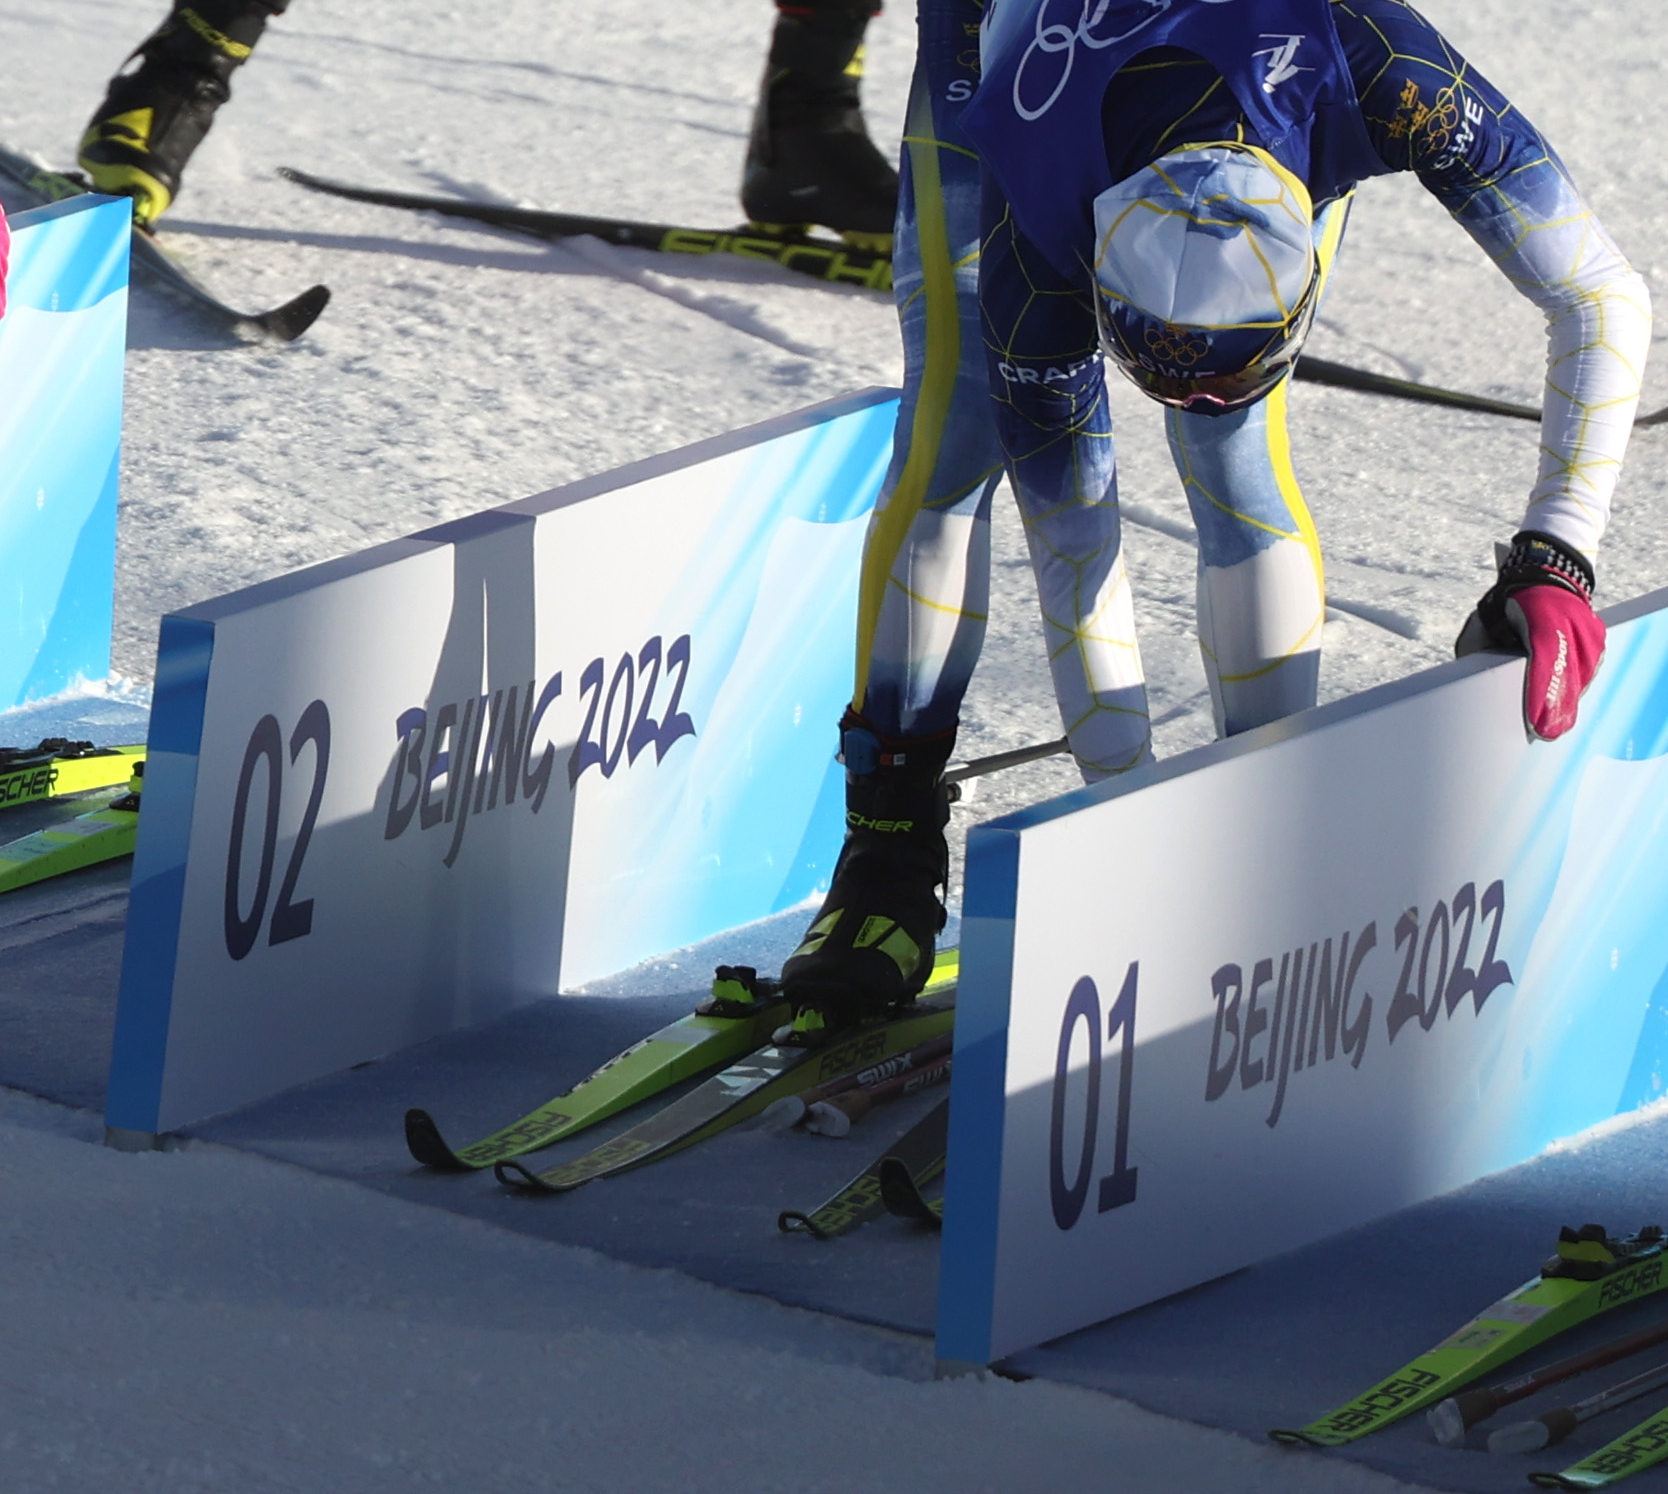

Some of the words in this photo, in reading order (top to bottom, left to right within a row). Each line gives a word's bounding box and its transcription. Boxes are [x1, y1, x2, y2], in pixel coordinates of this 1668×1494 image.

[659, 228, 893, 291] FISCH
[224, 699, 332, 962] 02
[383, 671, 563, 869] BEIJING
[568, 633, 698, 792] 2022
[847, 810, 914, 833] CHER
[1049, 960, 1140, 1231] 01
[1204, 920, 1378, 1129] BEIJING
[1386, 879, 1515, 1046] 2022
[1598, 1260, 1663, 1308] FISCHER
[1318, 1368, 1442, 1434] FISCHER
[1576, 1417, 1668, 1475] SCHER
